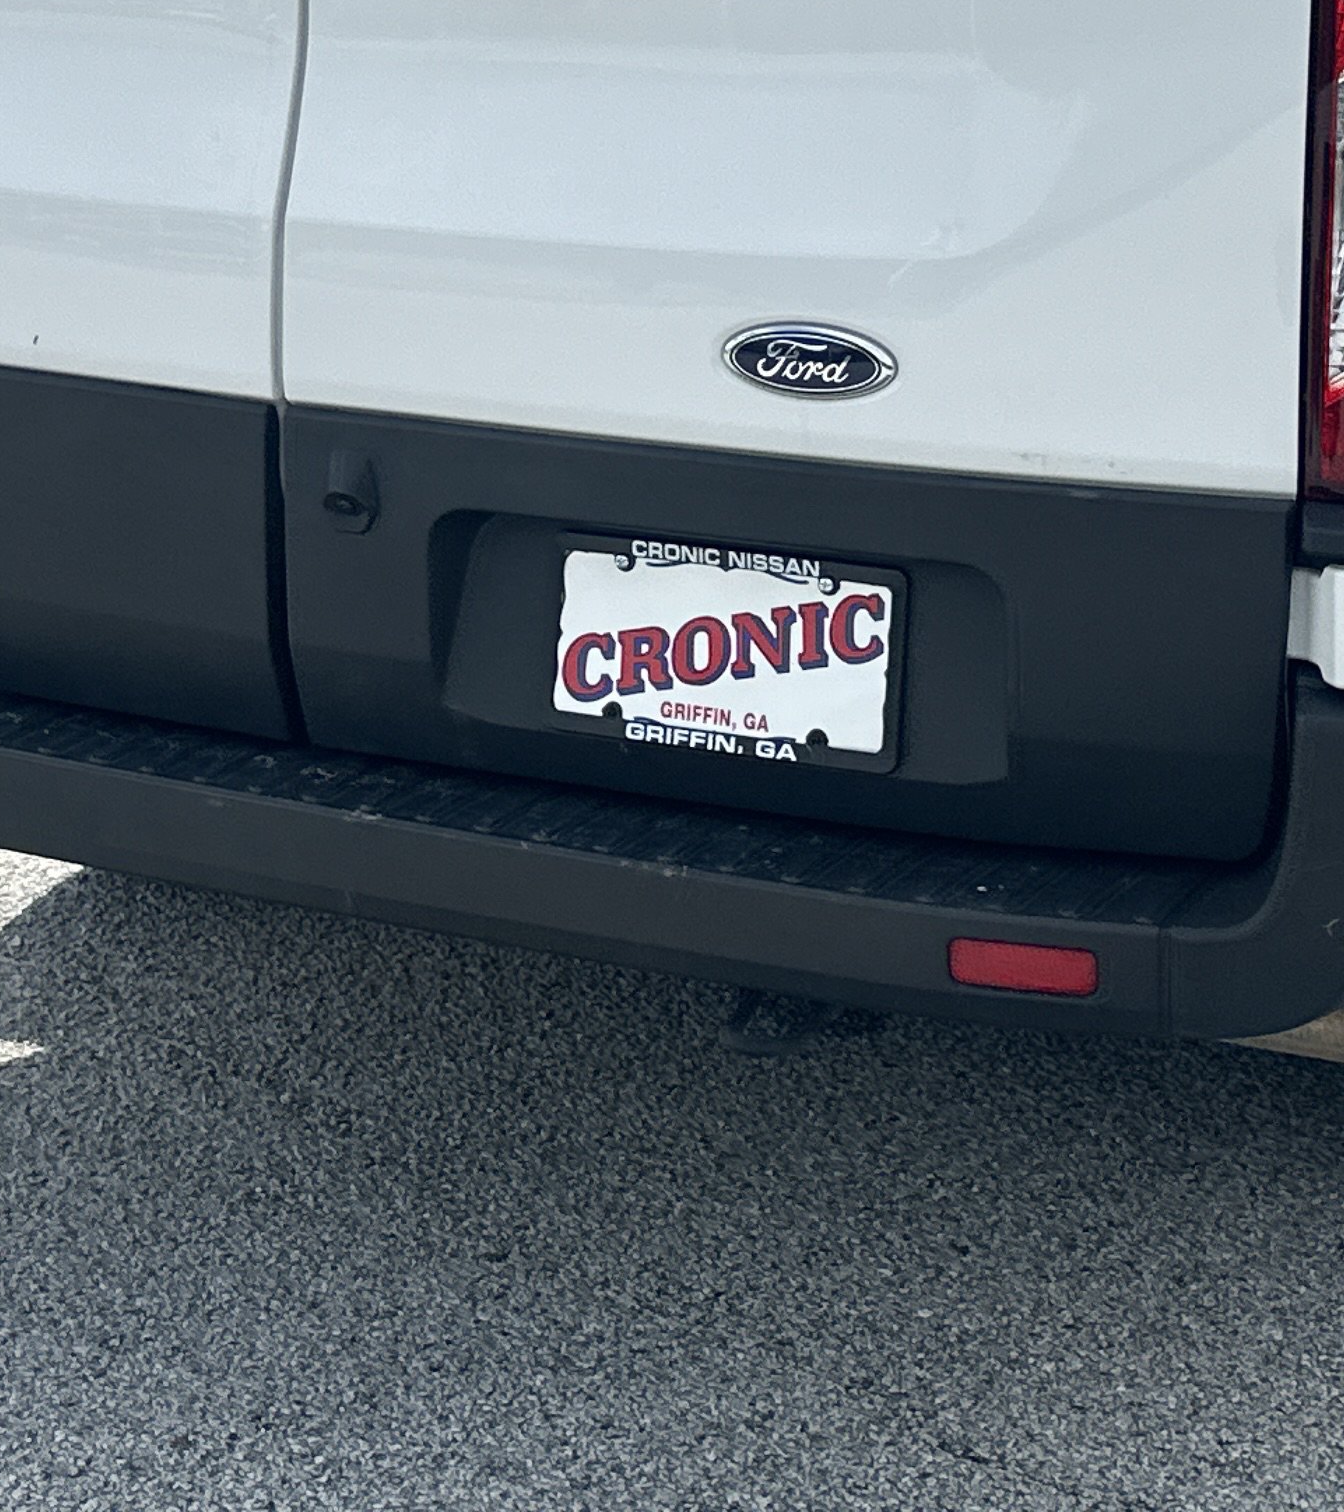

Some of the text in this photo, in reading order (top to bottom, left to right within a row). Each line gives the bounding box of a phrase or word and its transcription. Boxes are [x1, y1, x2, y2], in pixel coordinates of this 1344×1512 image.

[757, 339, 850, 383] Ford
[631, 539, 820, 578] CRONIC NISSAN
[562, 593, 885, 702] CRONIC
[743, 713, 769, 732] GA
[755, 739, 798, 762] GA
